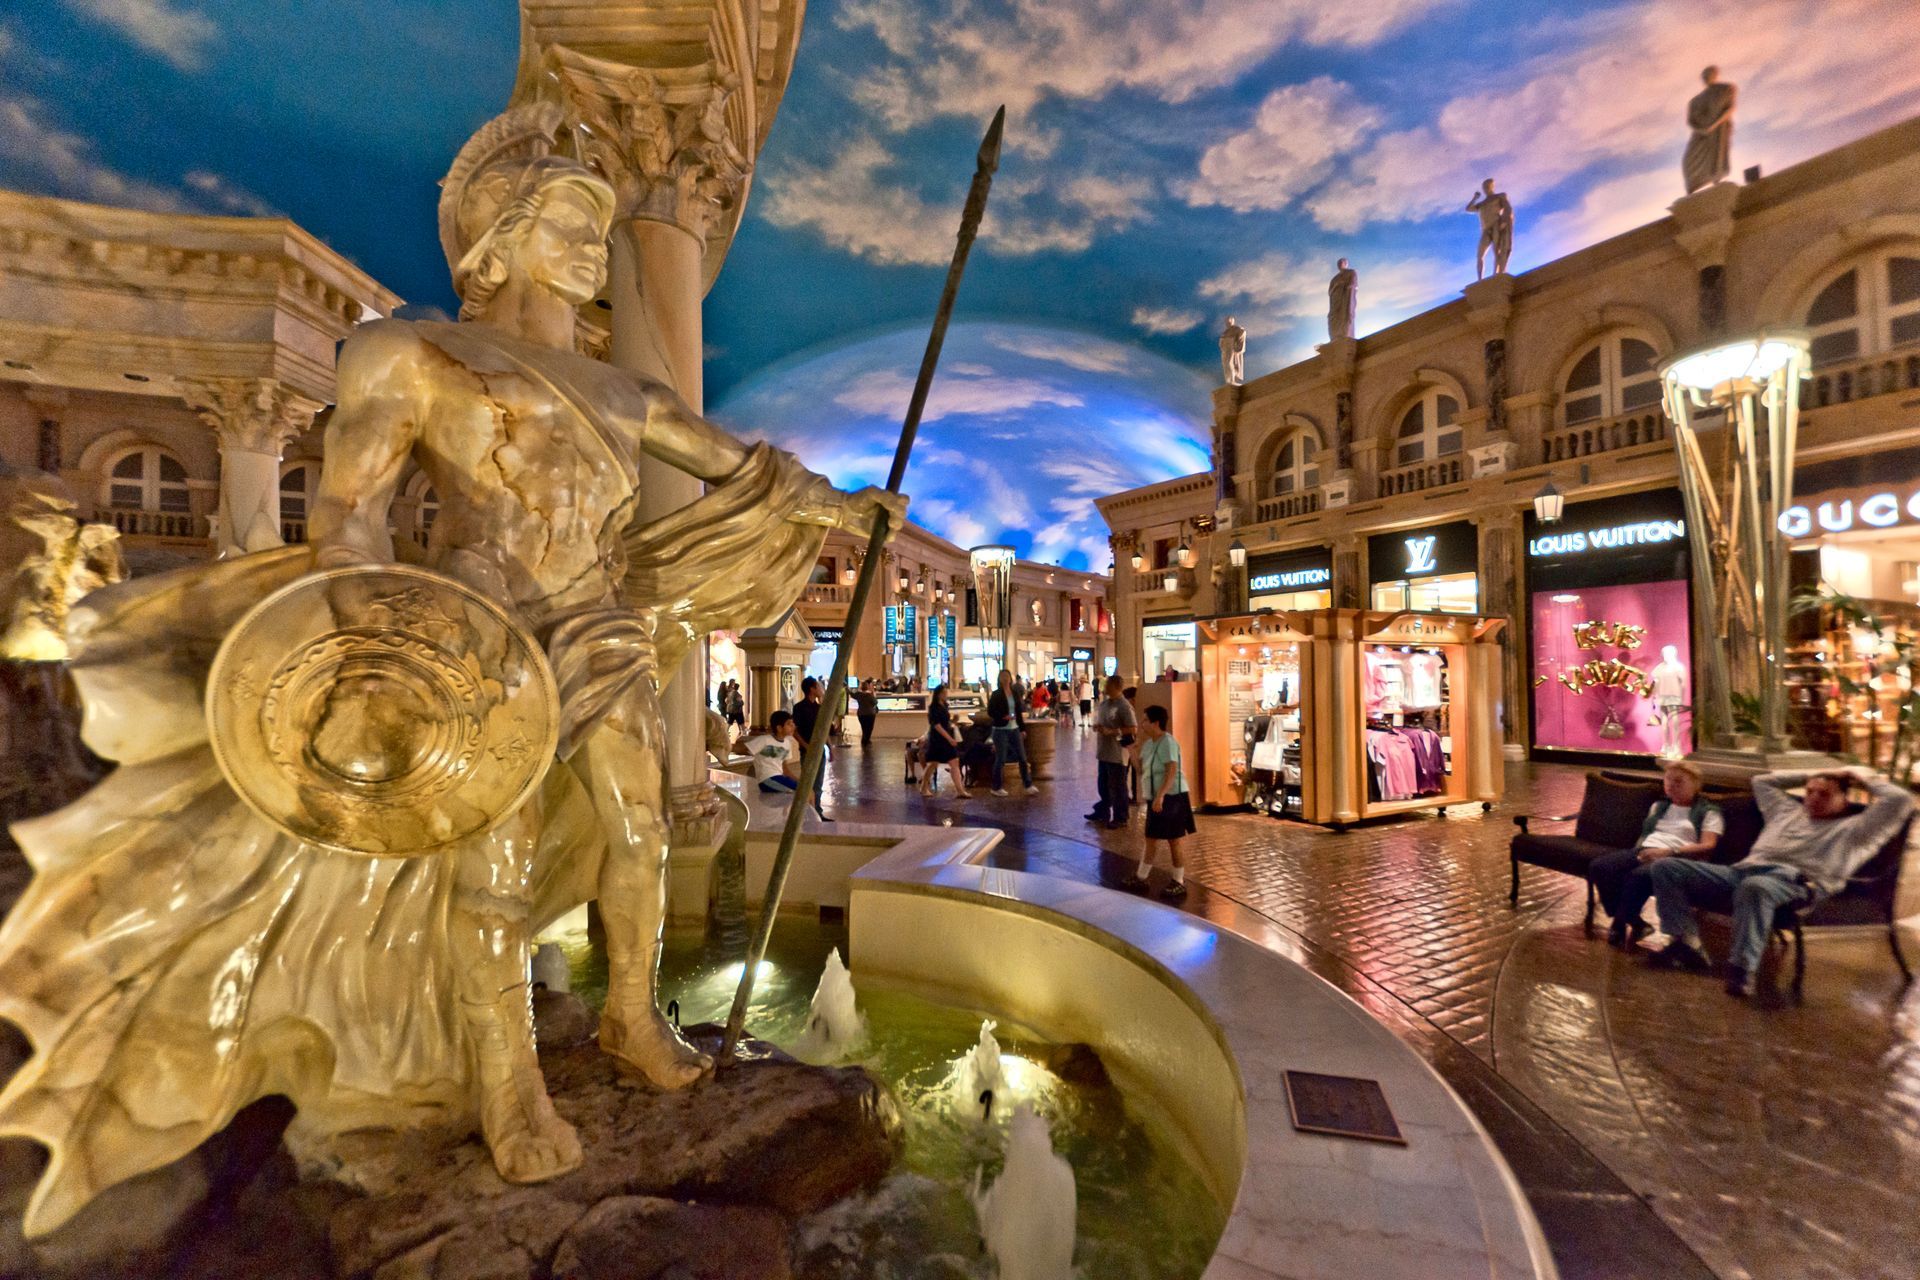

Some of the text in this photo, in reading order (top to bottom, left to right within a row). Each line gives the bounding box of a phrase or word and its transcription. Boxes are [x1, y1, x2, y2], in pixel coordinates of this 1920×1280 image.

[1530, 519, 1685, 556] LOUIS VUITTON
[1250, 568, 1330, 590] LOUIS VUITTON
